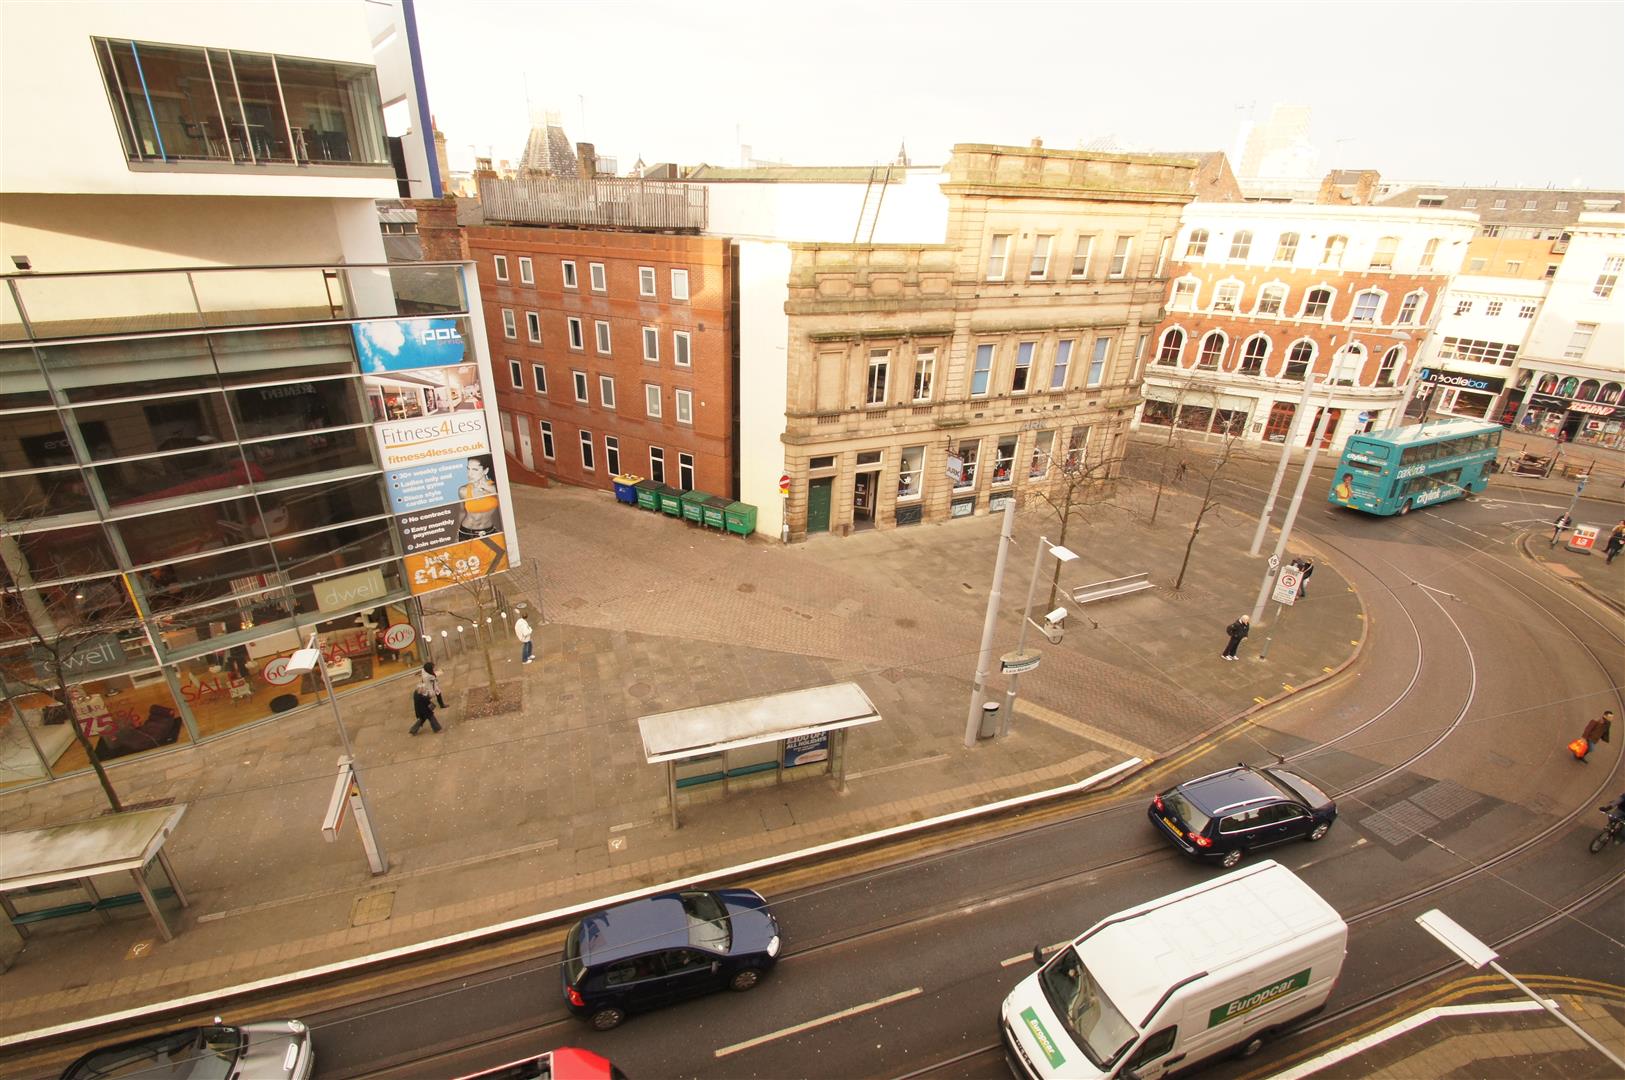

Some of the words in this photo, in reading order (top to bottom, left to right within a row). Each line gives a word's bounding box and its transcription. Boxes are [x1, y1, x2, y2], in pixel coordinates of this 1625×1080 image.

[381, 419, 482, 445] Fitness4Less
[388, 442, 485, 465] fitness4less.co.uk
[409, 515, 419, 523] No
[420, 509, 452, 521] contracts
[411, 525, 428, 535] Easy
[428, 519, 455, 530] monthly
[413, 528, 446, 540] payments
[415, 541, 430, 549] Join
[424, 551, 450, 568] just
[326, 575, 380, 605] dwell
[1227, 979, 1295, 1016] Europcar
[1030, 1018, 1056, 1054] Europcar
